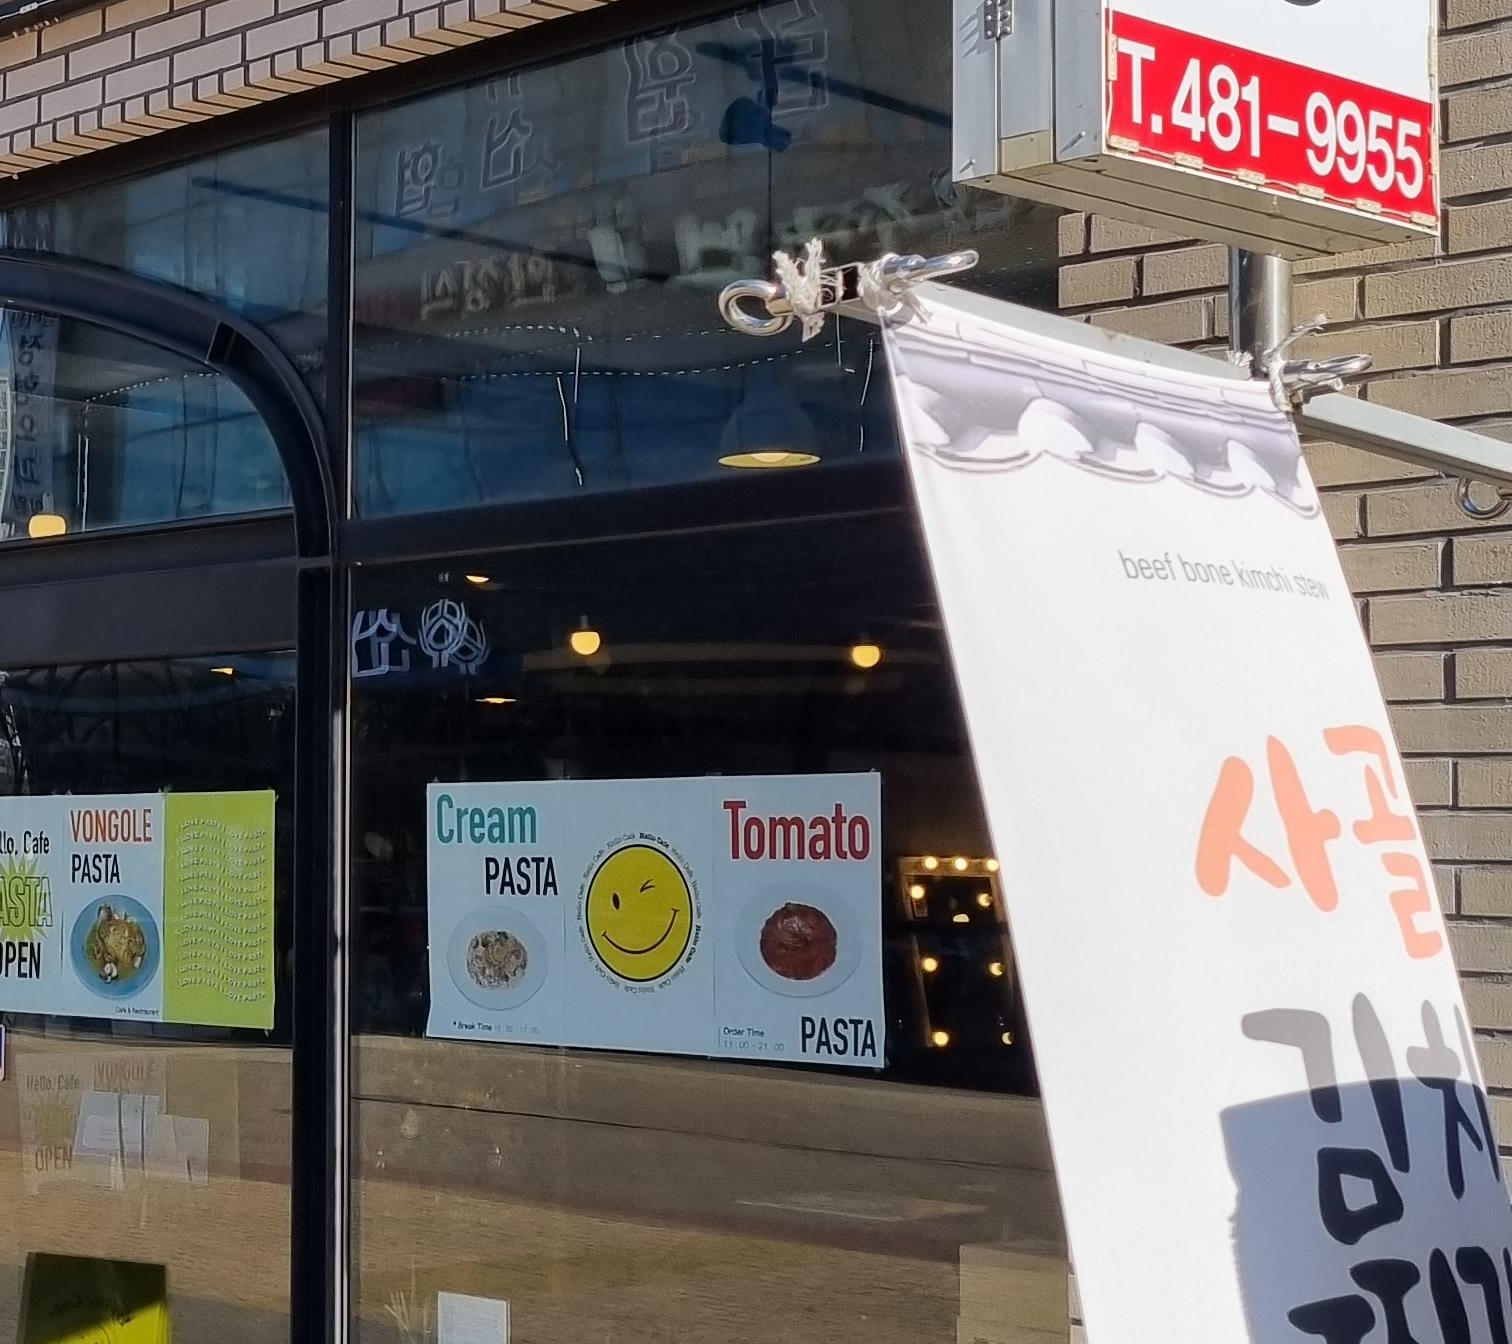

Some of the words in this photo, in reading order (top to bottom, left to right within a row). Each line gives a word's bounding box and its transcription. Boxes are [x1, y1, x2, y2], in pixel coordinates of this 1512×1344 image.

[1115, 39, 1425, 200] T.481-9955
[1118, 549, 1176, 583] beef
[1177, 552, 1235, 588] bone
[1235, 558, 1294, 596] kimchi
[1295, 571, 1331, 601] stew
[23, 829, 50, 855] Cafe
[70, 808, 153, 844] VONGOLE
[436, 792, 537, 845] Cream
[722, 799, 872, 862] Tomato
[1194, 724, 1444, 960] 사골
[70, 853, 121, 884] PASTA
[484, 855, 559, 897] PASTA
[747, 1028, 765, 1038] Time
[800, 1015, 877, 1058] PASTA
[1240, 991, 1502, 1246] 김치
